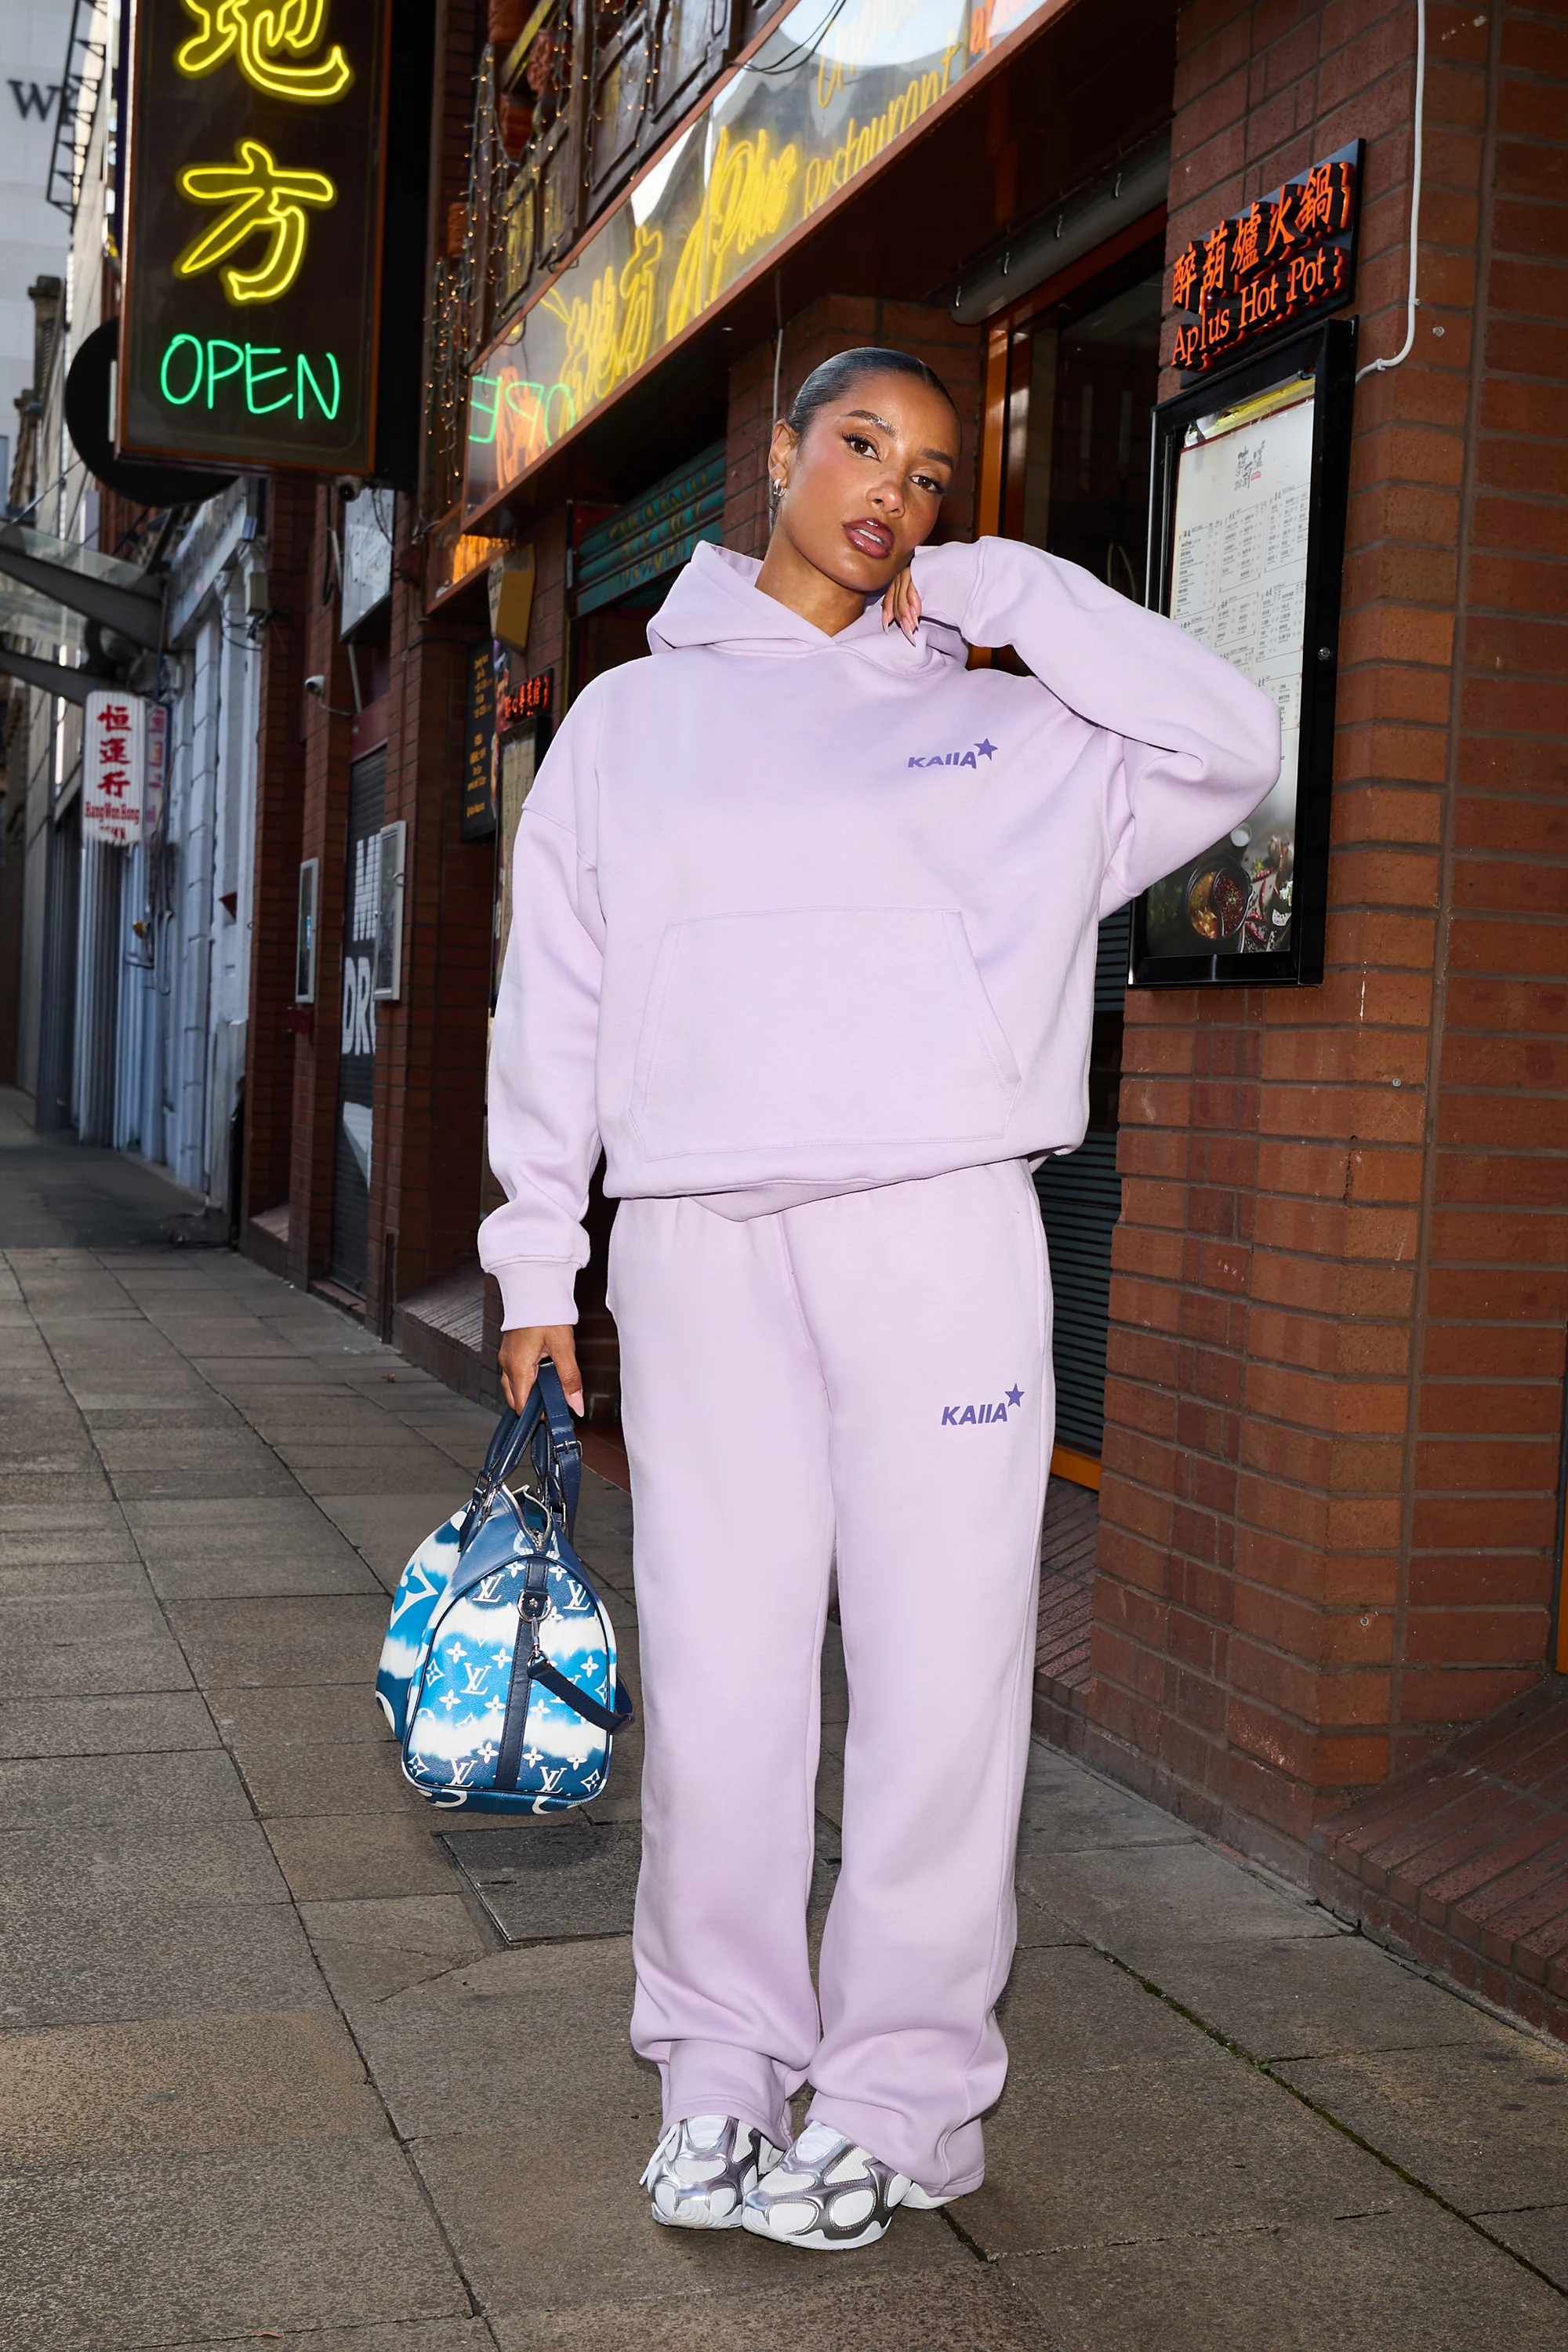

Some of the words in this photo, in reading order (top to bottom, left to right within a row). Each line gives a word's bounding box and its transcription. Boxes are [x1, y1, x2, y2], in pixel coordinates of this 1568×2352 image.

[1171, 307, 1230, 367] Aplus
[1238, 274, 1279, 329] Hot
[1286, 247, 1326, 303] Pot
[162, 334, 339, 419] OPEN
[908, 751, 977, 769] KAIIA
[942, 1403, 1007, 1425] KAIIA
